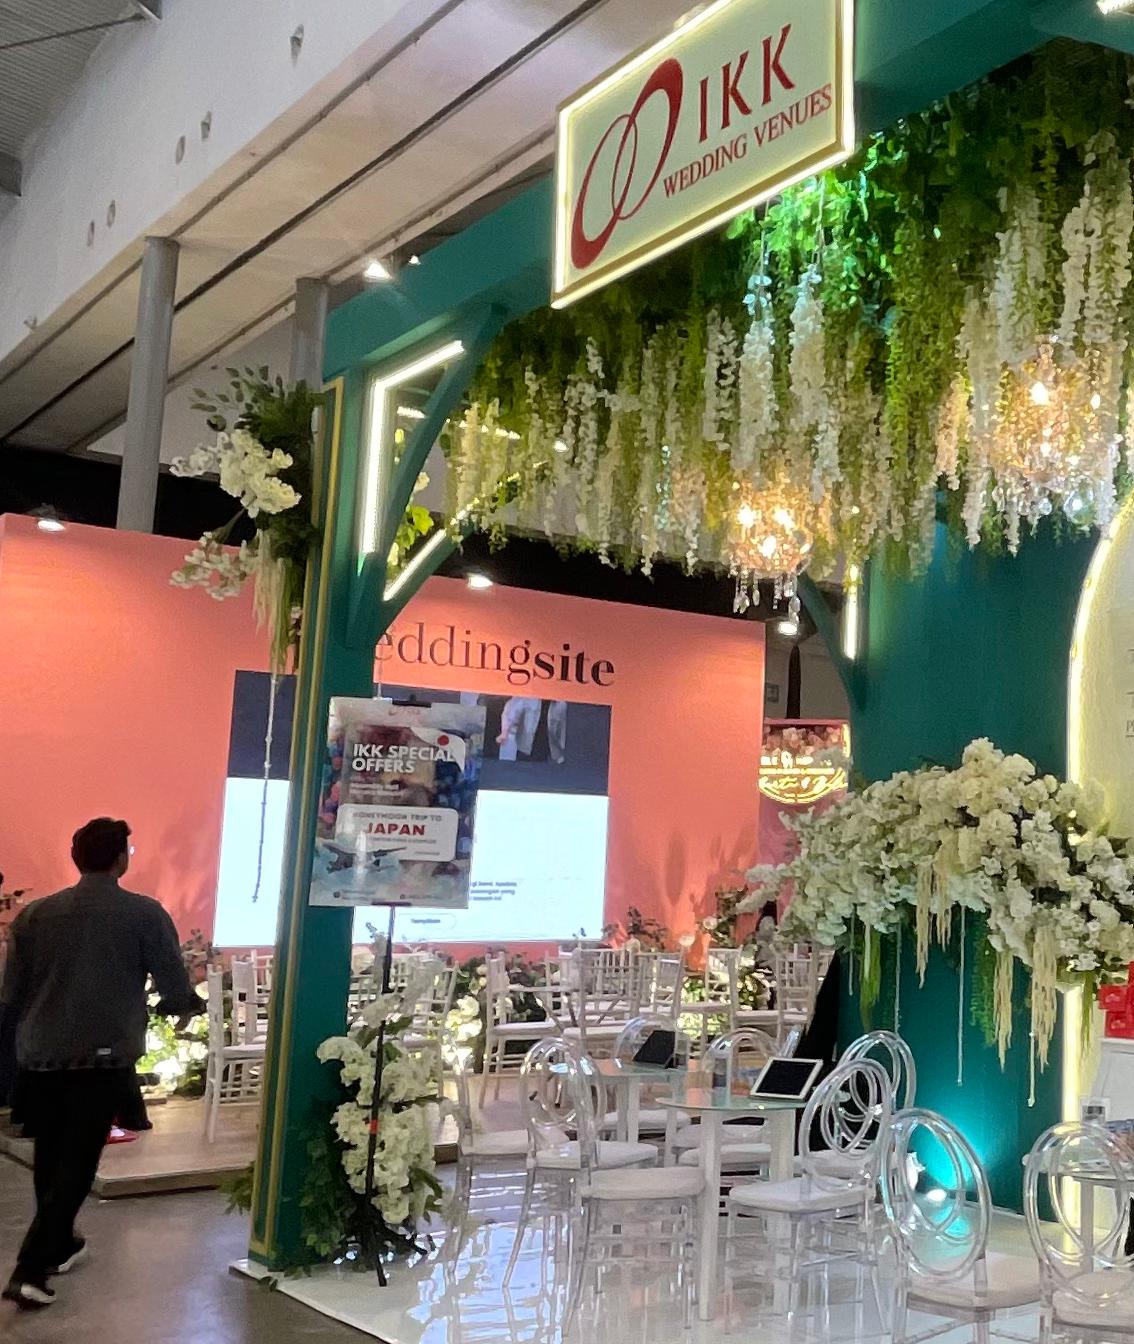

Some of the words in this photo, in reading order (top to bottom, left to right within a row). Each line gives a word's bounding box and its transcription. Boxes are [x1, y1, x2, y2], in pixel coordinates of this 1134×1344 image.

[699, 23, 796, 143] IKK
[663, 133, 748, 198] WEDDING
[753, 83, 832, 147] VENUES
[374, 622, 615, 686] eddingsite
[351, 757, 416, 774] OFFERS
[353, 743, 383, 758] IKK
[387, 745, 457, 762] SPECIAL
[367, 822, 426, 836] JAPAN
